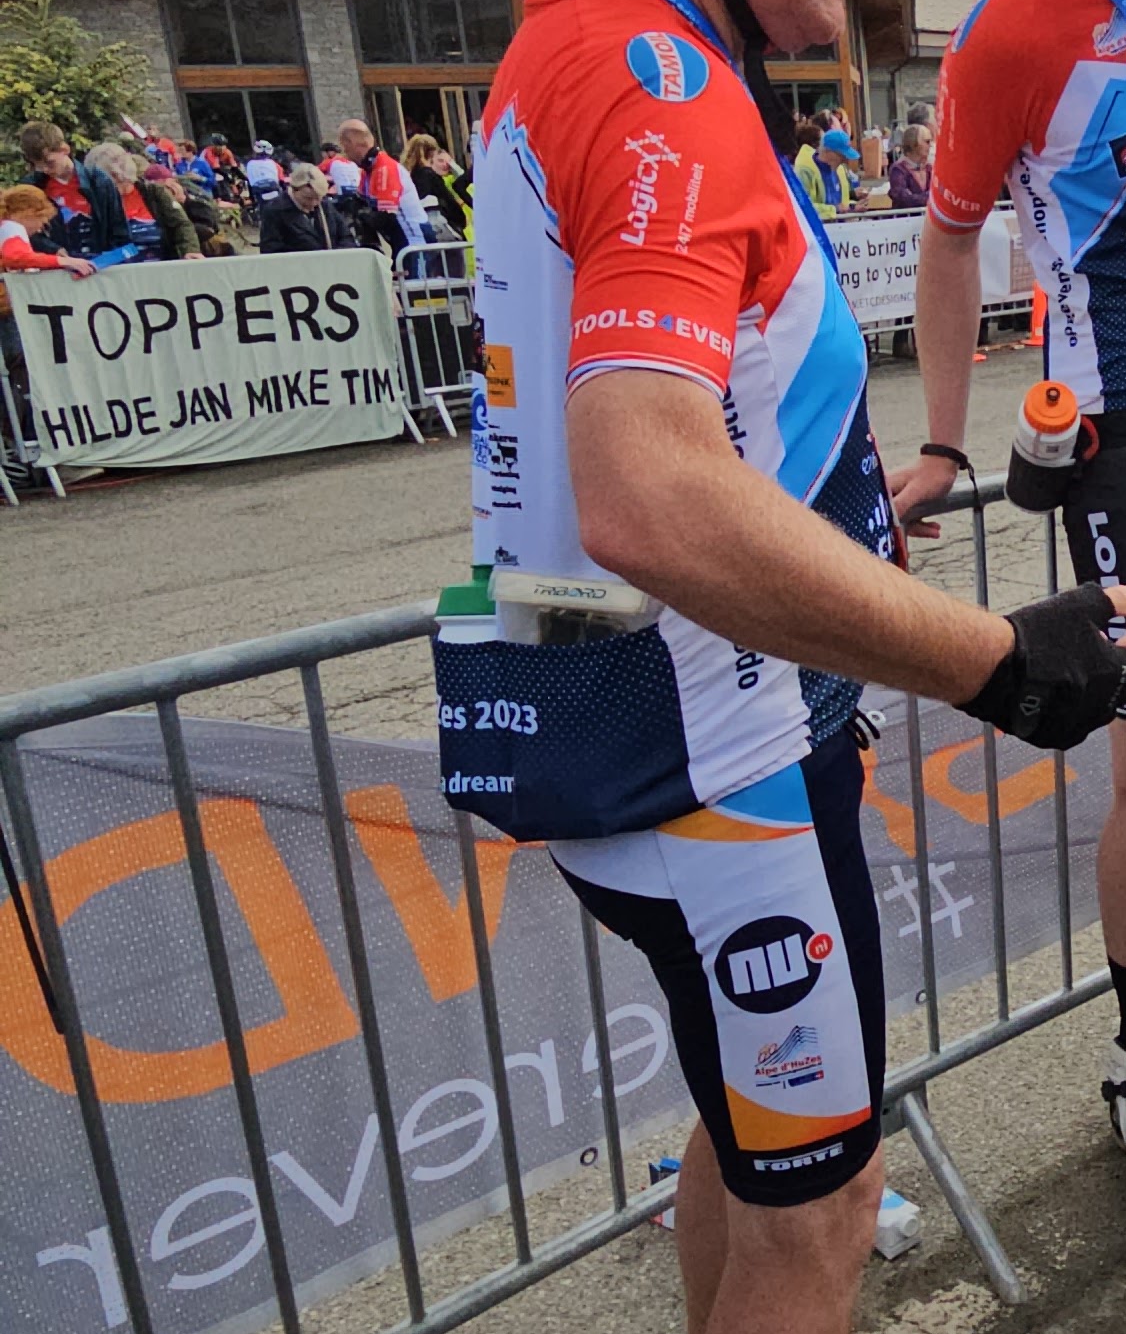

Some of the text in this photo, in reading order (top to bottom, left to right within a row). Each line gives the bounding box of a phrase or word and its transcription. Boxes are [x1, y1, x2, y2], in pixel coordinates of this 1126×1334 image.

[834, 242, 861, 259] We
[867, 238, 906, 258] bring
[867, 267, 879, 281] to
[27, 283, 360, 365] TOPPERS
[574, 308, 733, 361] TOOLS4EVER
[42, 396, 160, 450] HILDE
[169, 382, 233, 429] JAN
[246, 369, 330, 418] MIKE
[474, 699, 539, 735] 2023
